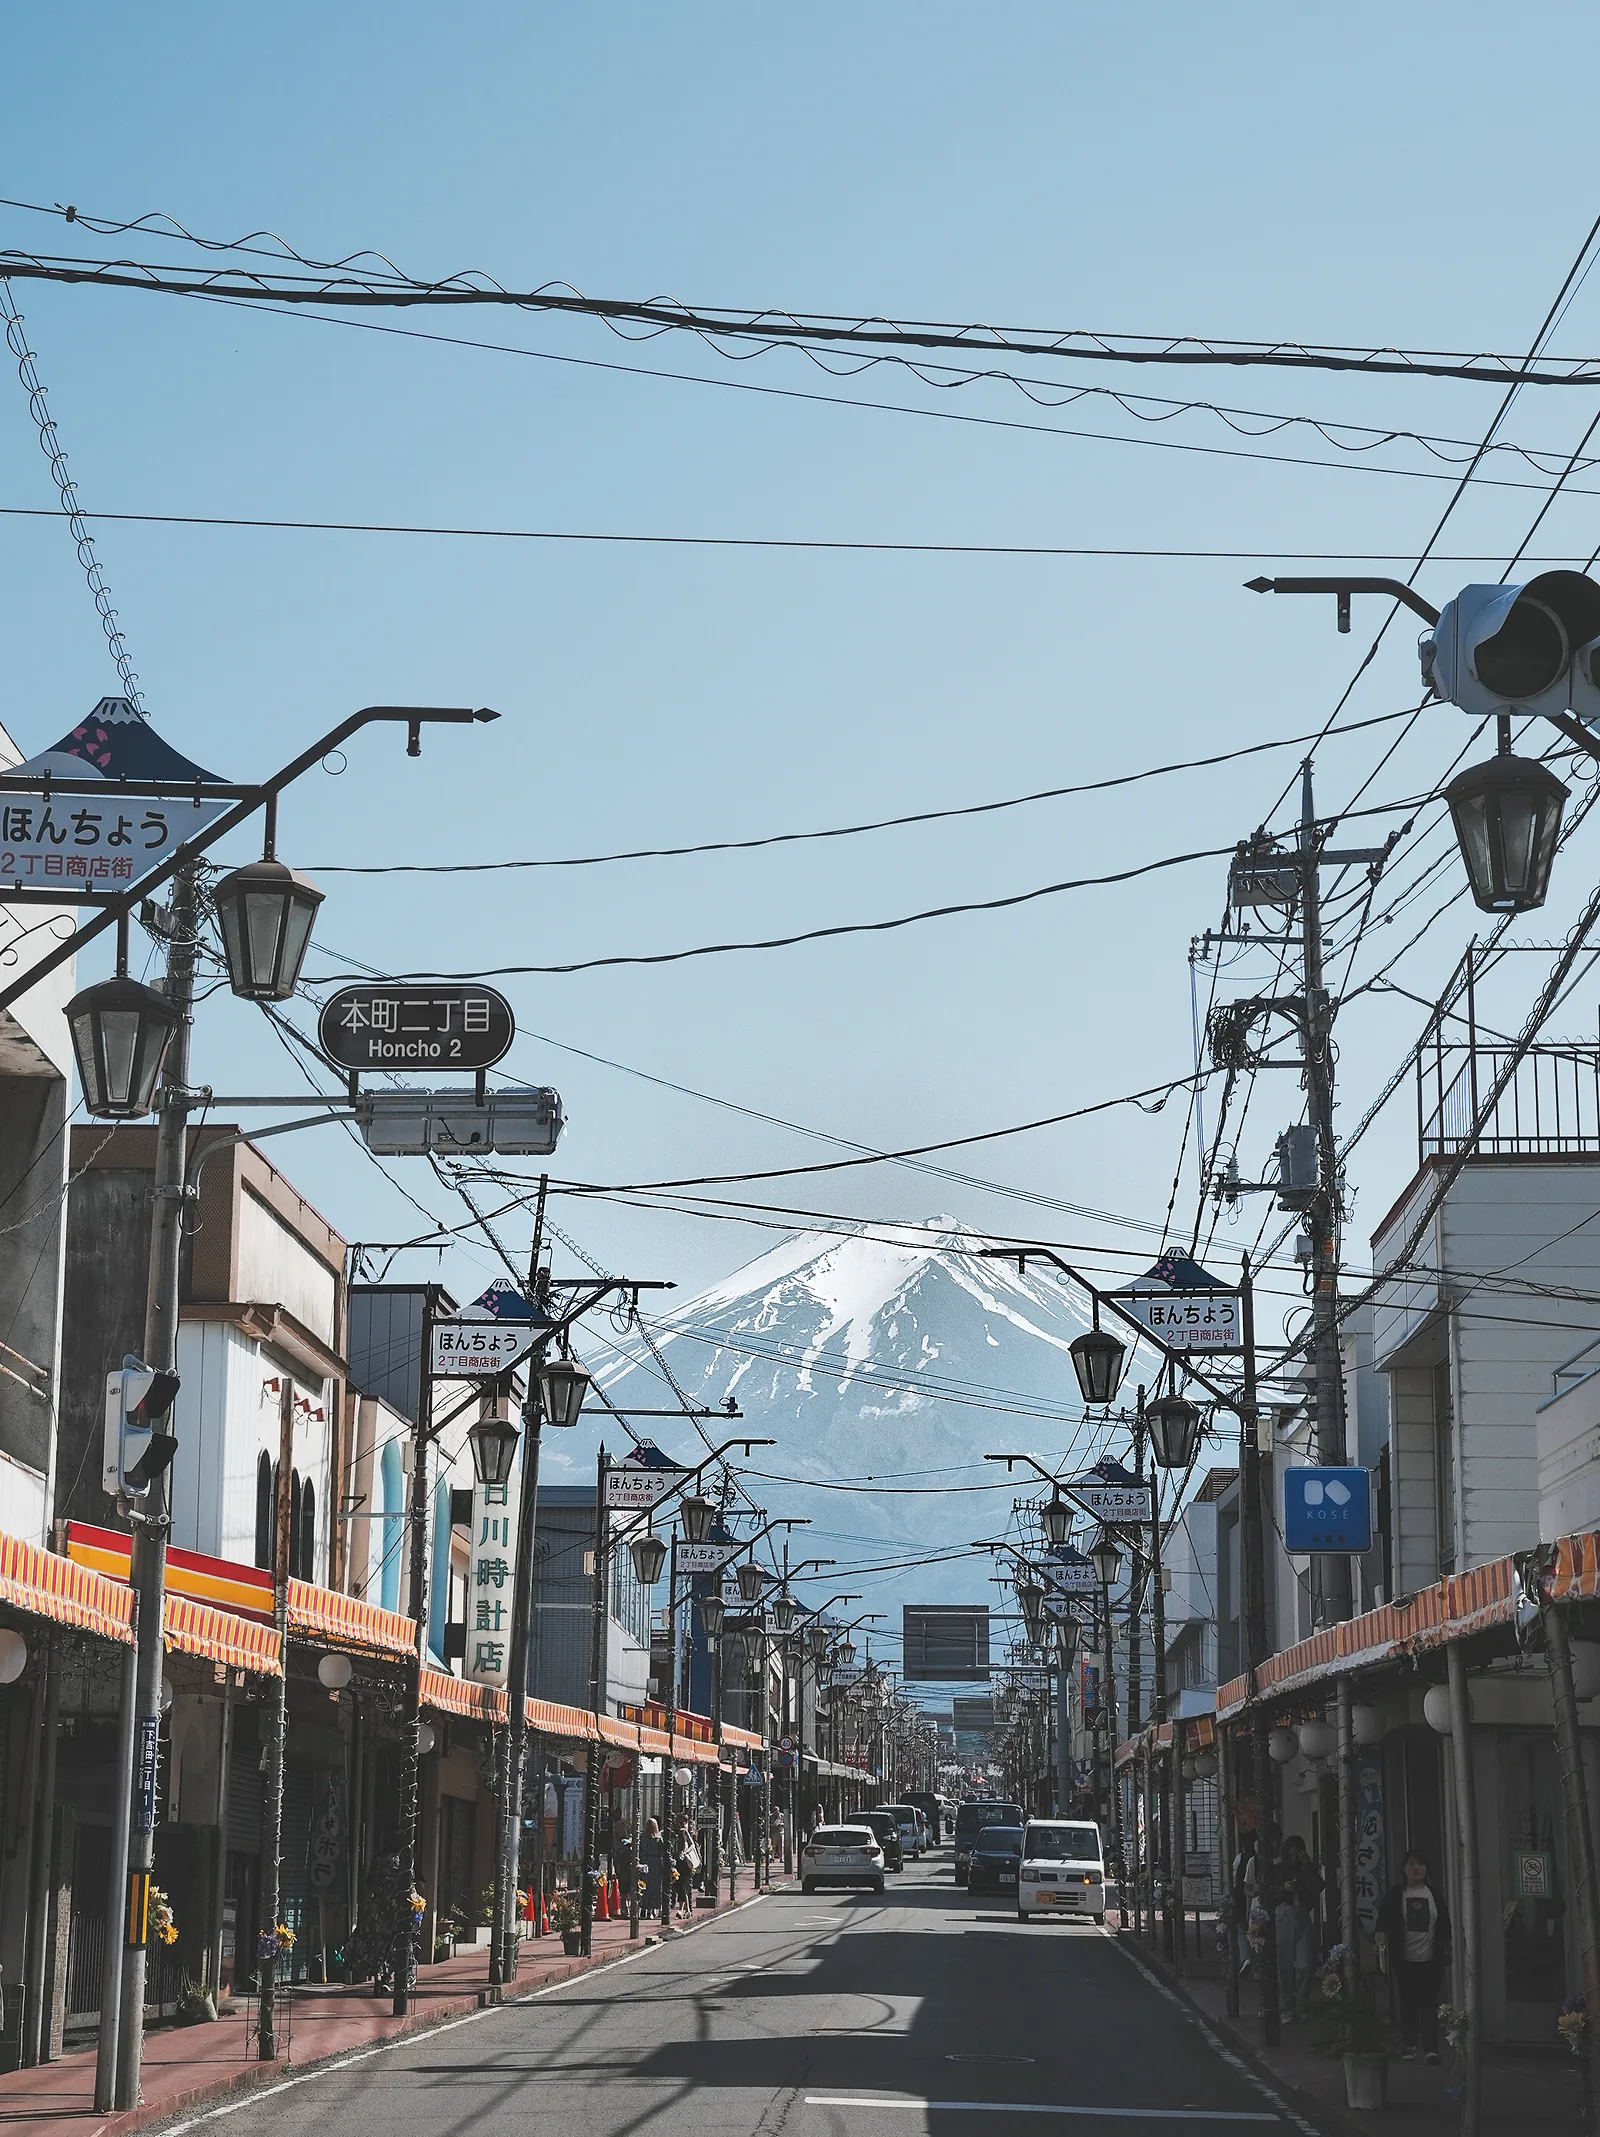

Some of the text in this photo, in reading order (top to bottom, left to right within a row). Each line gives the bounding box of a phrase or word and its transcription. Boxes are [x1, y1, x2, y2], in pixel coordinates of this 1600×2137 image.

[3, 806, 169, 850] ほんちょう
[0, 852, 133, 880] 2丁目商店街
[340, 998, 490, 1034] 本町二丁目
[369, 1039, 462, 1058] Honcho 2
[1149, 1304, 1235, 1326] ほんちょう
[439, 1332, 518, 1352] ほんちょう
[1166, 1329, 1235, 1342] 2丁目商店街
[438, 1355, 501, 1368] 2丁目商店街
[610, 1476, 665, 1492] ほんちょう
[1091, 1492, 1146, 1506] ほんちょう
[1306, 1508, 1350, 1520] KOSÉ
[680, 1548, 725, 1560] ほんちょう
[144, 1730, 155, 1790] 下吉田二丁目
[143, 1793, 149, 1806] 1
